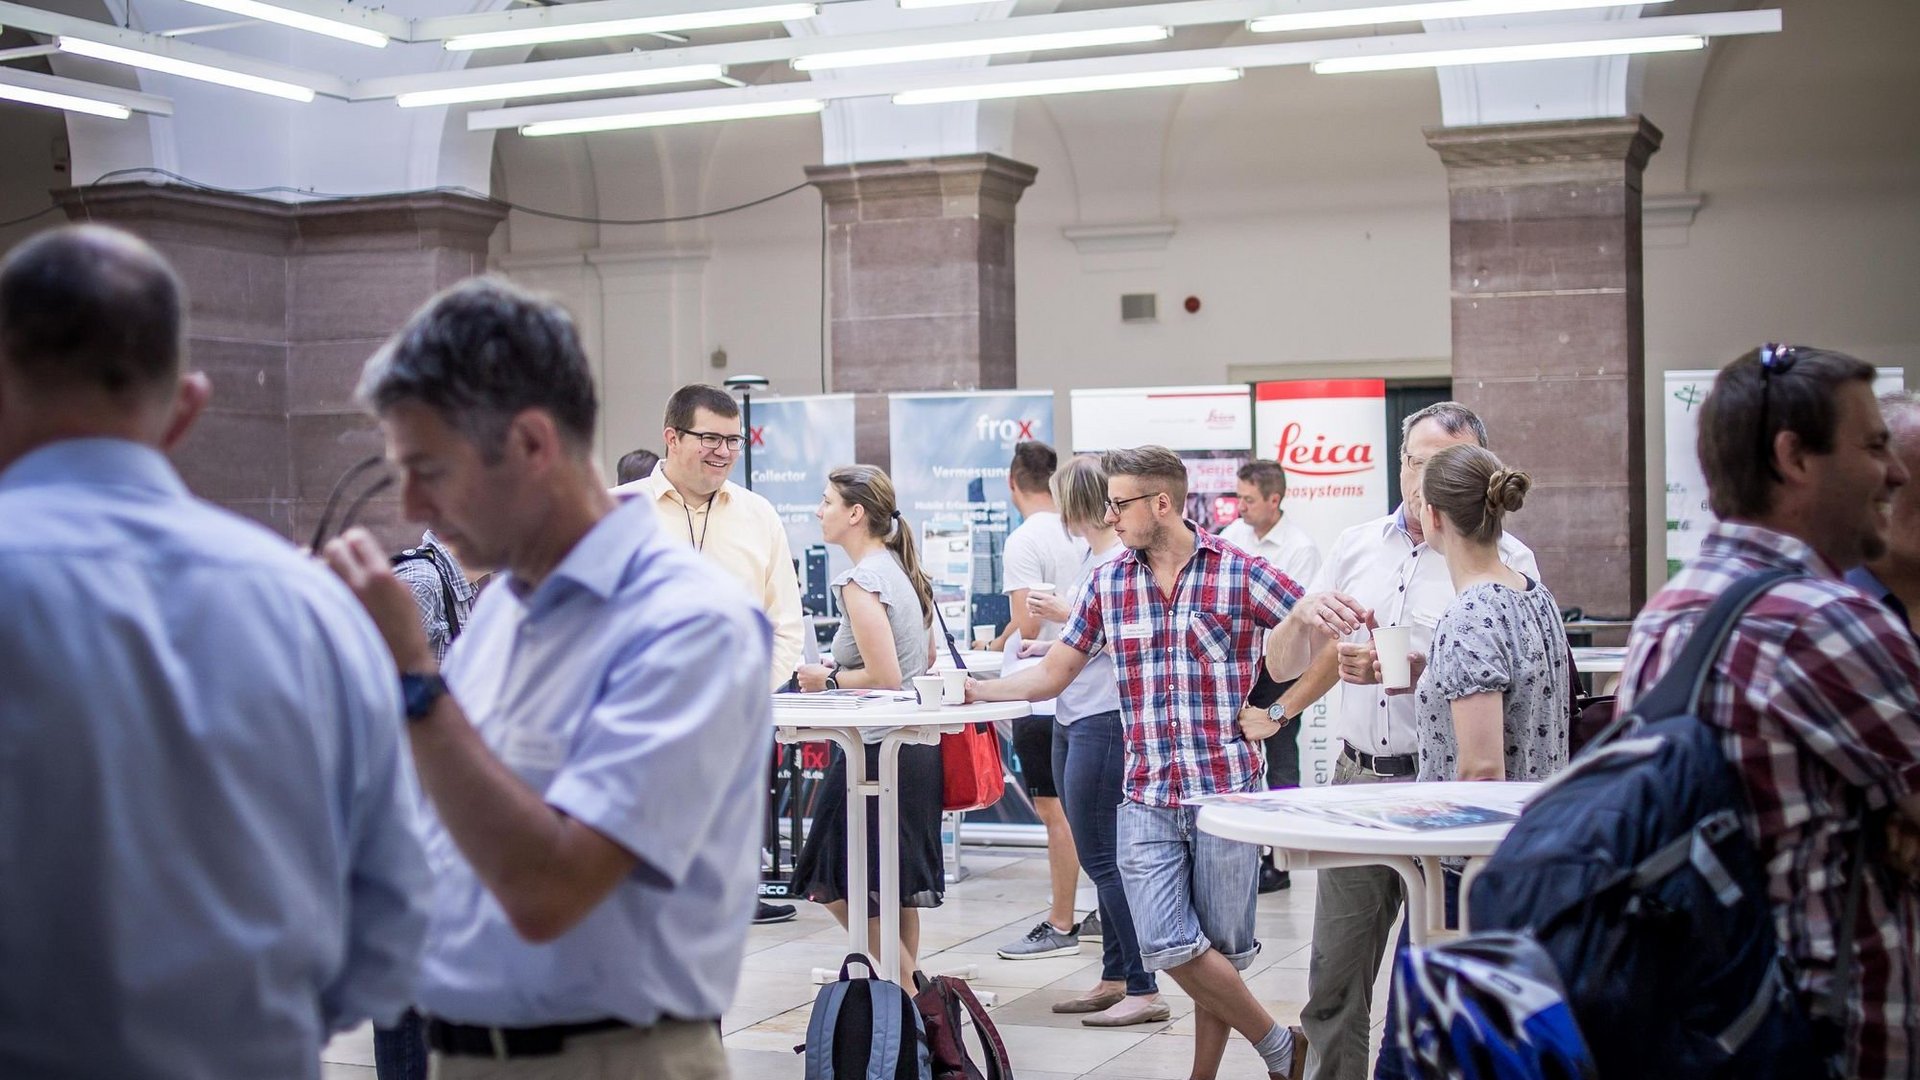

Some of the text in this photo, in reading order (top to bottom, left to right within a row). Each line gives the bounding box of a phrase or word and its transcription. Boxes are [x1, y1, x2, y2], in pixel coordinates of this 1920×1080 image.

[976, 414, 1033, 441] frox
[1275, 422, 1374, 470] Leica
[751, 469, 806, 482] Collector
[1286, 484, 1365, 500] eosystems
[1309, 696, 1328, 787] en it ha
